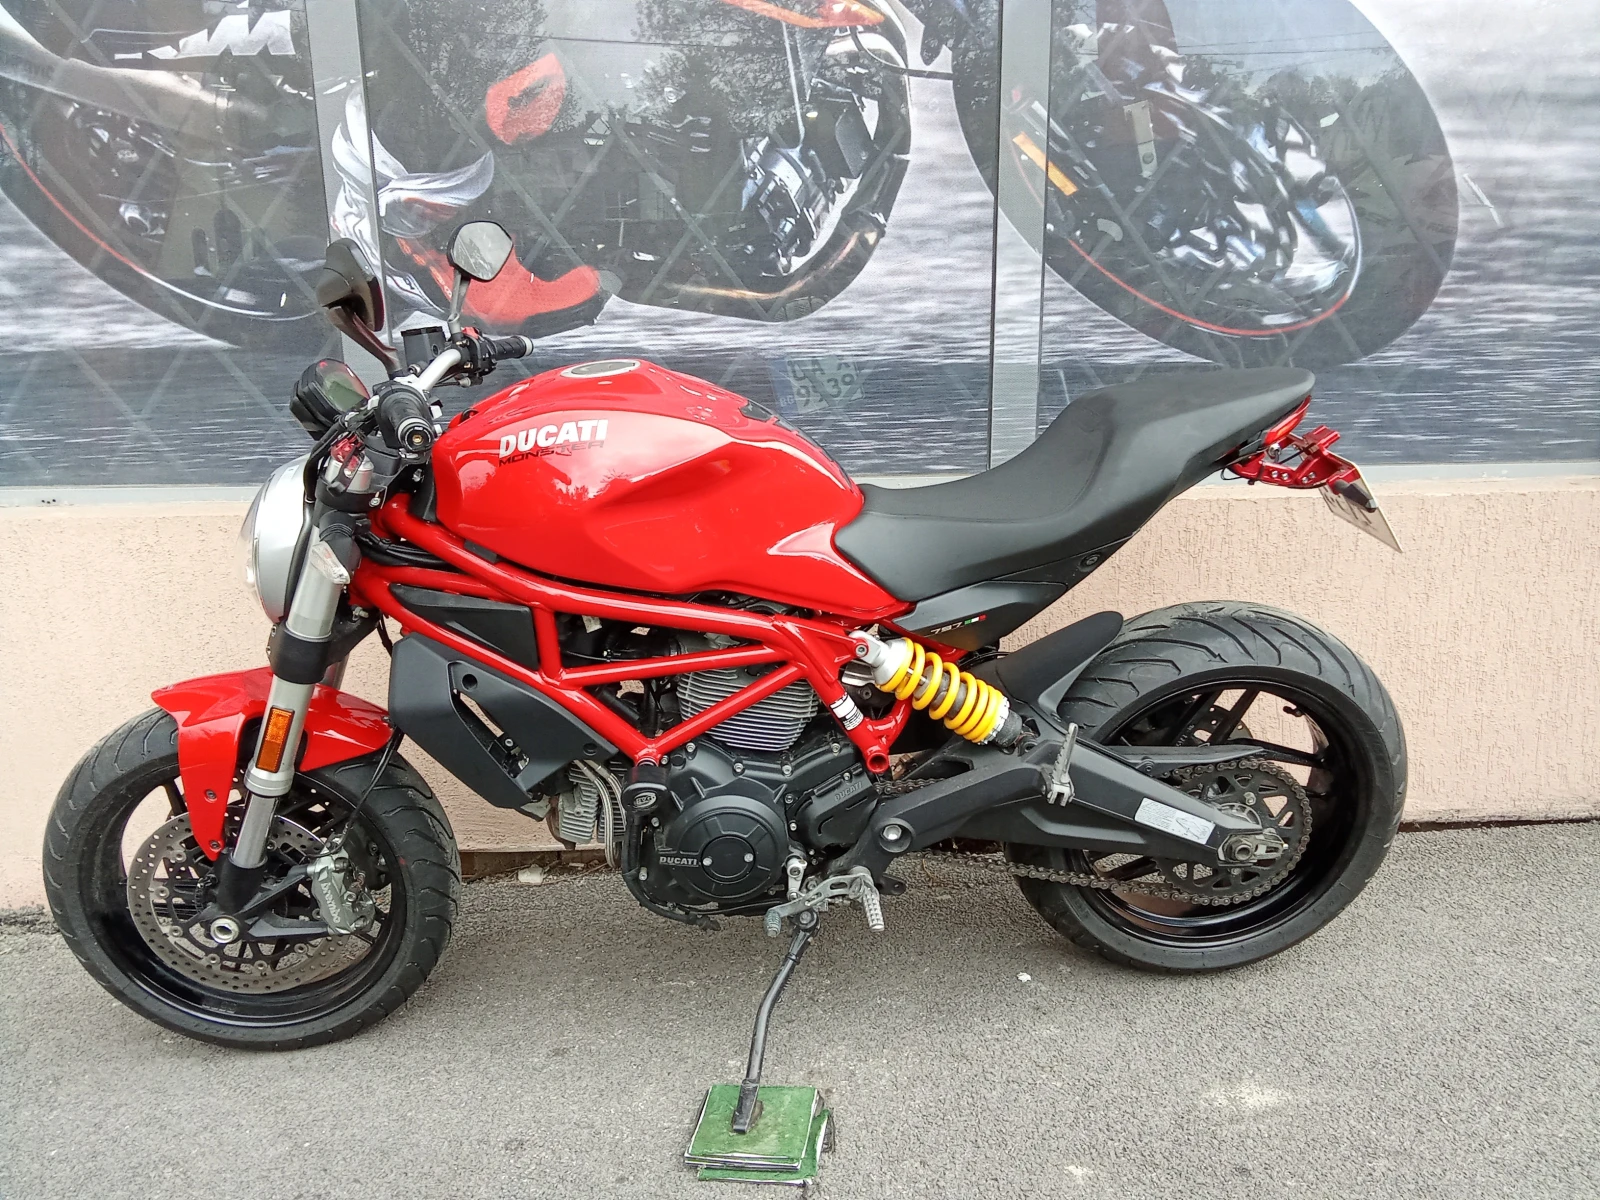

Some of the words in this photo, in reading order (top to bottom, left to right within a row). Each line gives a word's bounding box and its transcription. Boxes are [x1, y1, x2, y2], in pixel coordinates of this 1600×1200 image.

[499, 419, 609, 458] DUCATI
[499, 440, 605, 467] MONSTER
[834, 781, 862, 802] DUCATI
[659, 856, 698, 866] DUCATI
[320, 882, 341, 924] brembo
